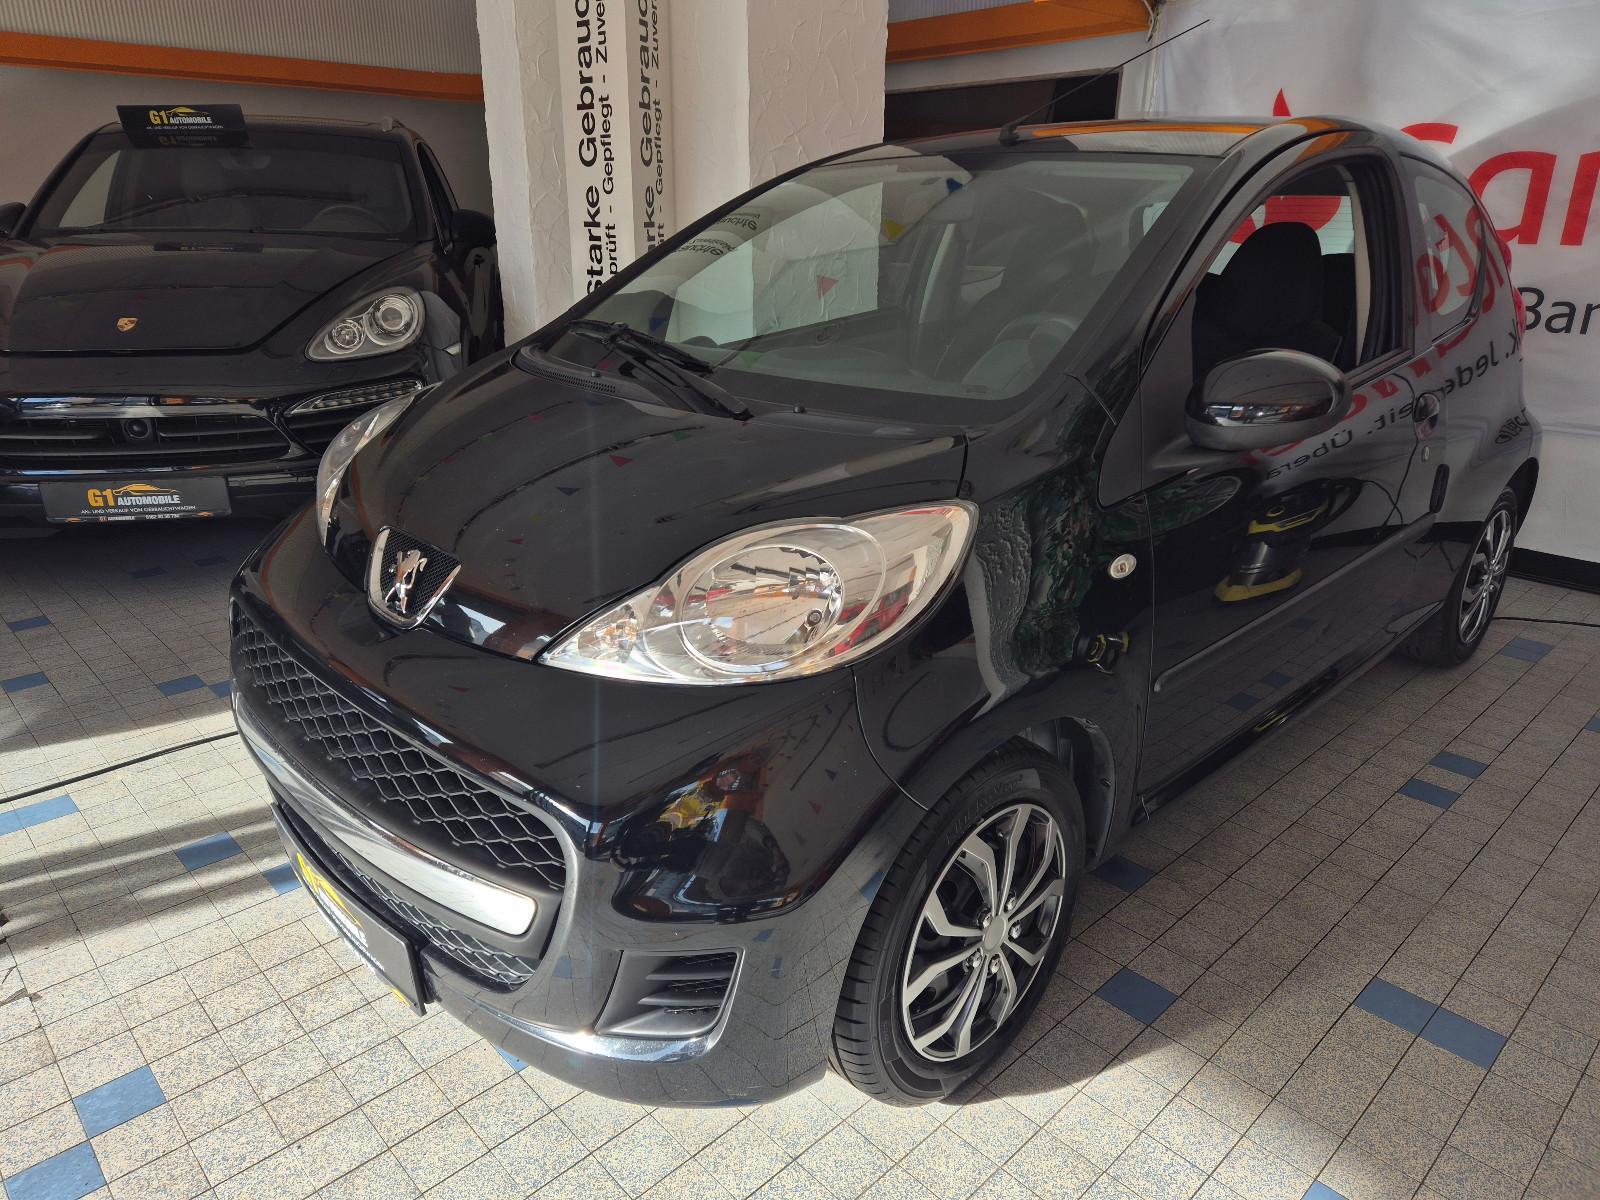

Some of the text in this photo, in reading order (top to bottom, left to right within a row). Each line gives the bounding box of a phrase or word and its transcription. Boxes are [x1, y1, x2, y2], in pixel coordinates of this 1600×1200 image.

[596, 0, 607, 63] Zuve
[149, 110, 212, 124] G1 AUTOMOBILE
[599, 94, 614, 195] Gepflegt
[653, 99, 664, 195] Gepflegt
[87, 488, 181, 507] G1 AUTOMOBILE
